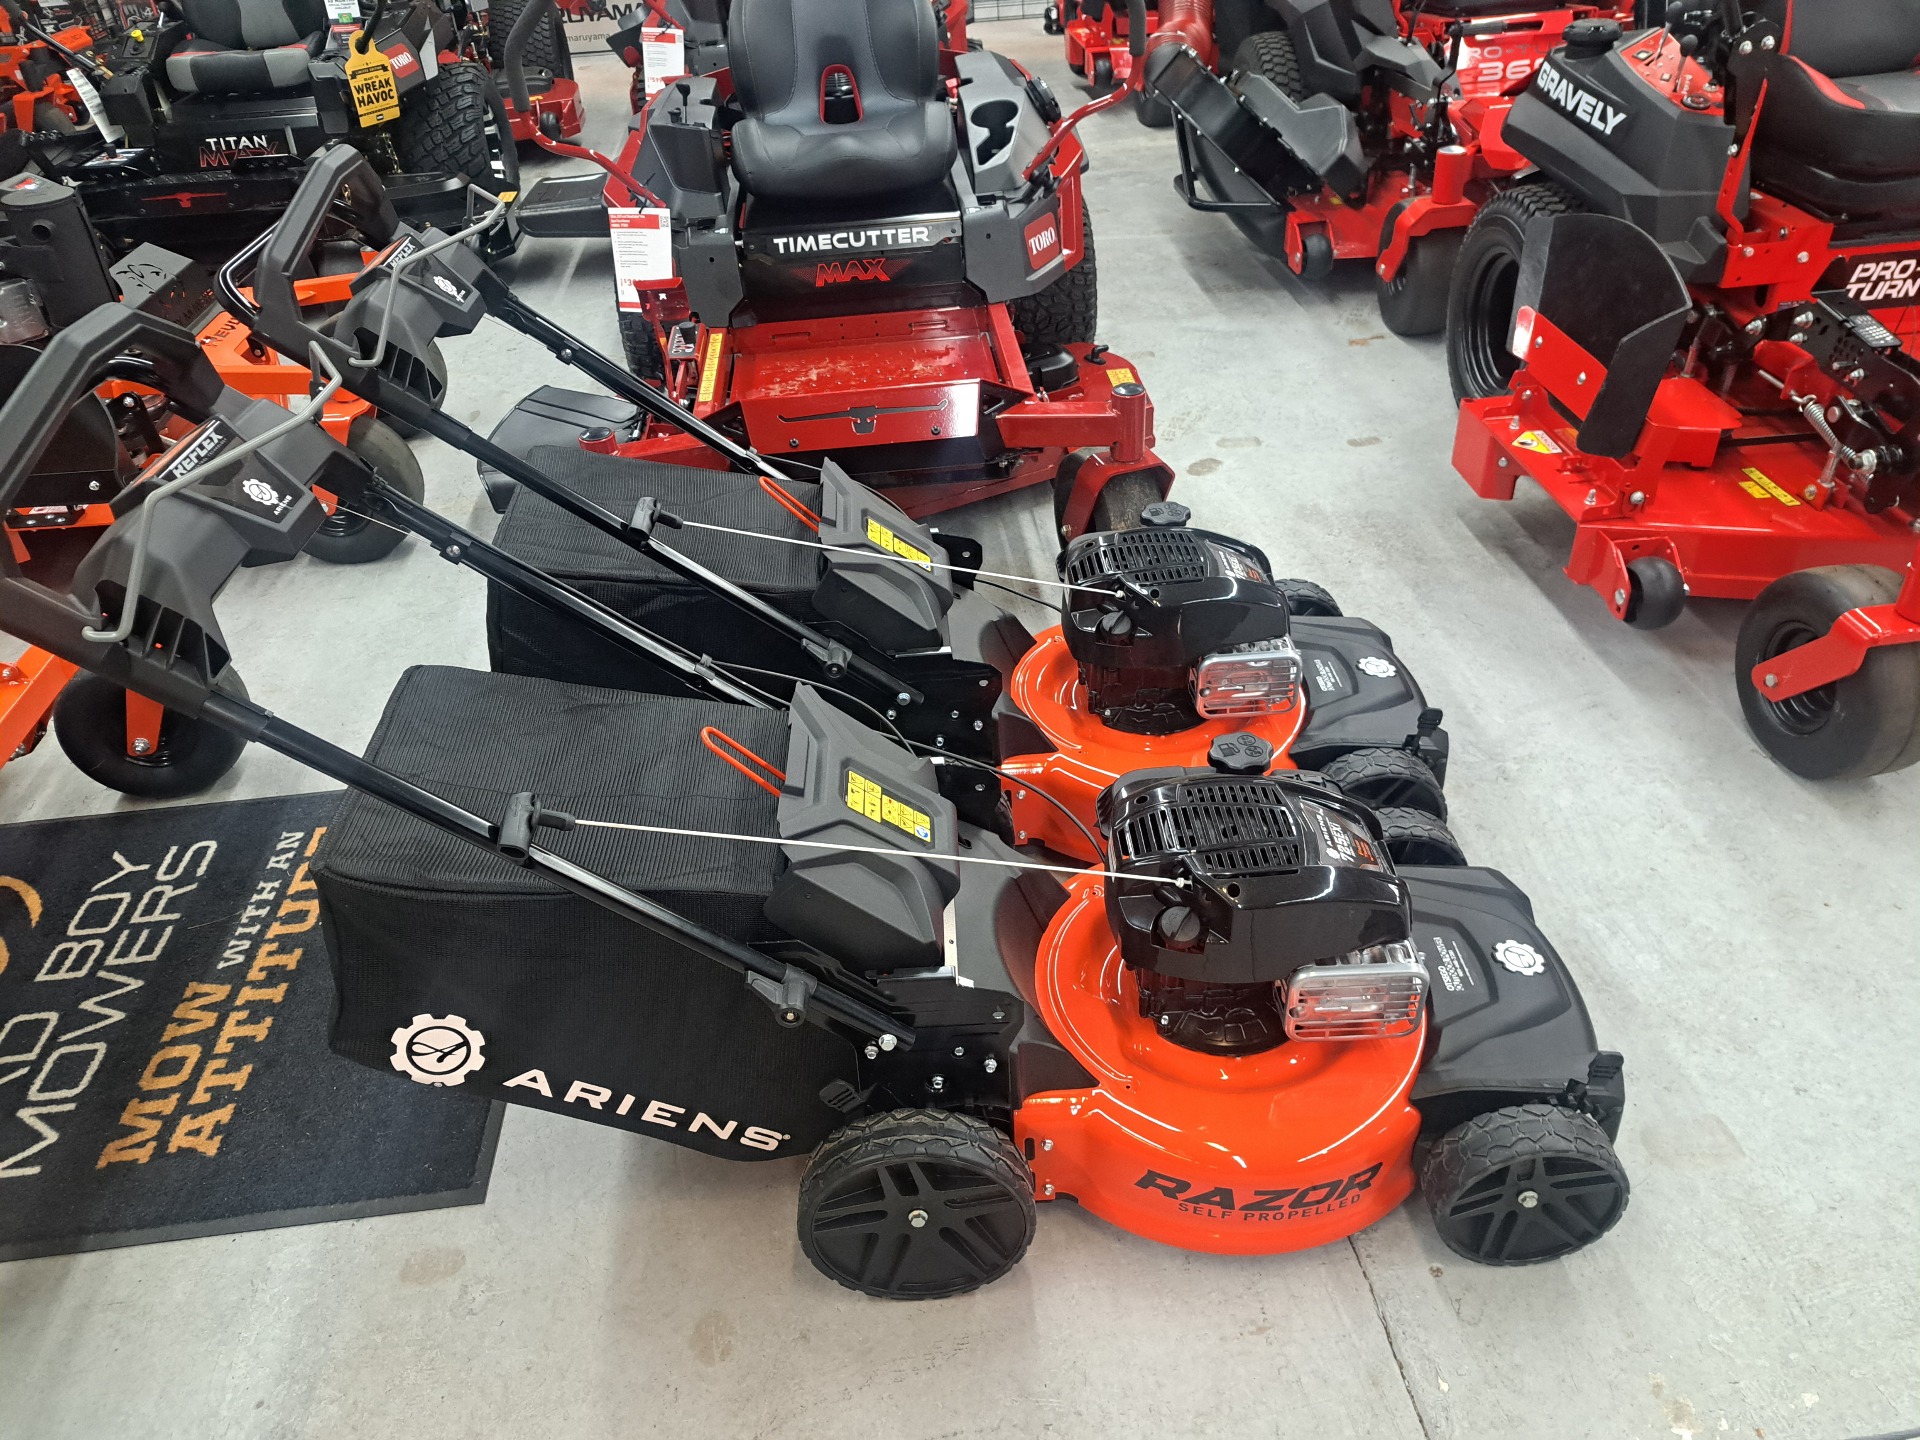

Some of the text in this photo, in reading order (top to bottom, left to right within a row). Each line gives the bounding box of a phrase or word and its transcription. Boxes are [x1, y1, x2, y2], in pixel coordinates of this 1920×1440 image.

[389, 51, 412, 70] TORO
[1477, 58, 1545, 82] 36
[354, 77, 392, 96] WREAK
[357, 89, 395, 108] HAVOC
[1536, 60, 1628, 136] GRAVELY
[205, 134, 268, 151] TITAN
[772, 226, 931, 255] TIMECUTTER
[1028, 226, 1056, 256] TORO
[816, 258, 891, 288] MAX
[1845, 278, 1920, 302] TURN
[171, 430, 224, 479] REFLEX
[1315, 813, 1333, 847] ARIENS
[35, 851, 151, 982] BOY
[0, 839, 218, 1178] MOWERS
[96, 831, 305, 1169] MOW WITH AN
[502, 1068, 783, 1151] ARIENS
[1134, 1161, 1383, 1212] RAZOR
[1178, 1193, 1362, 1221] SELF PROPELLED
